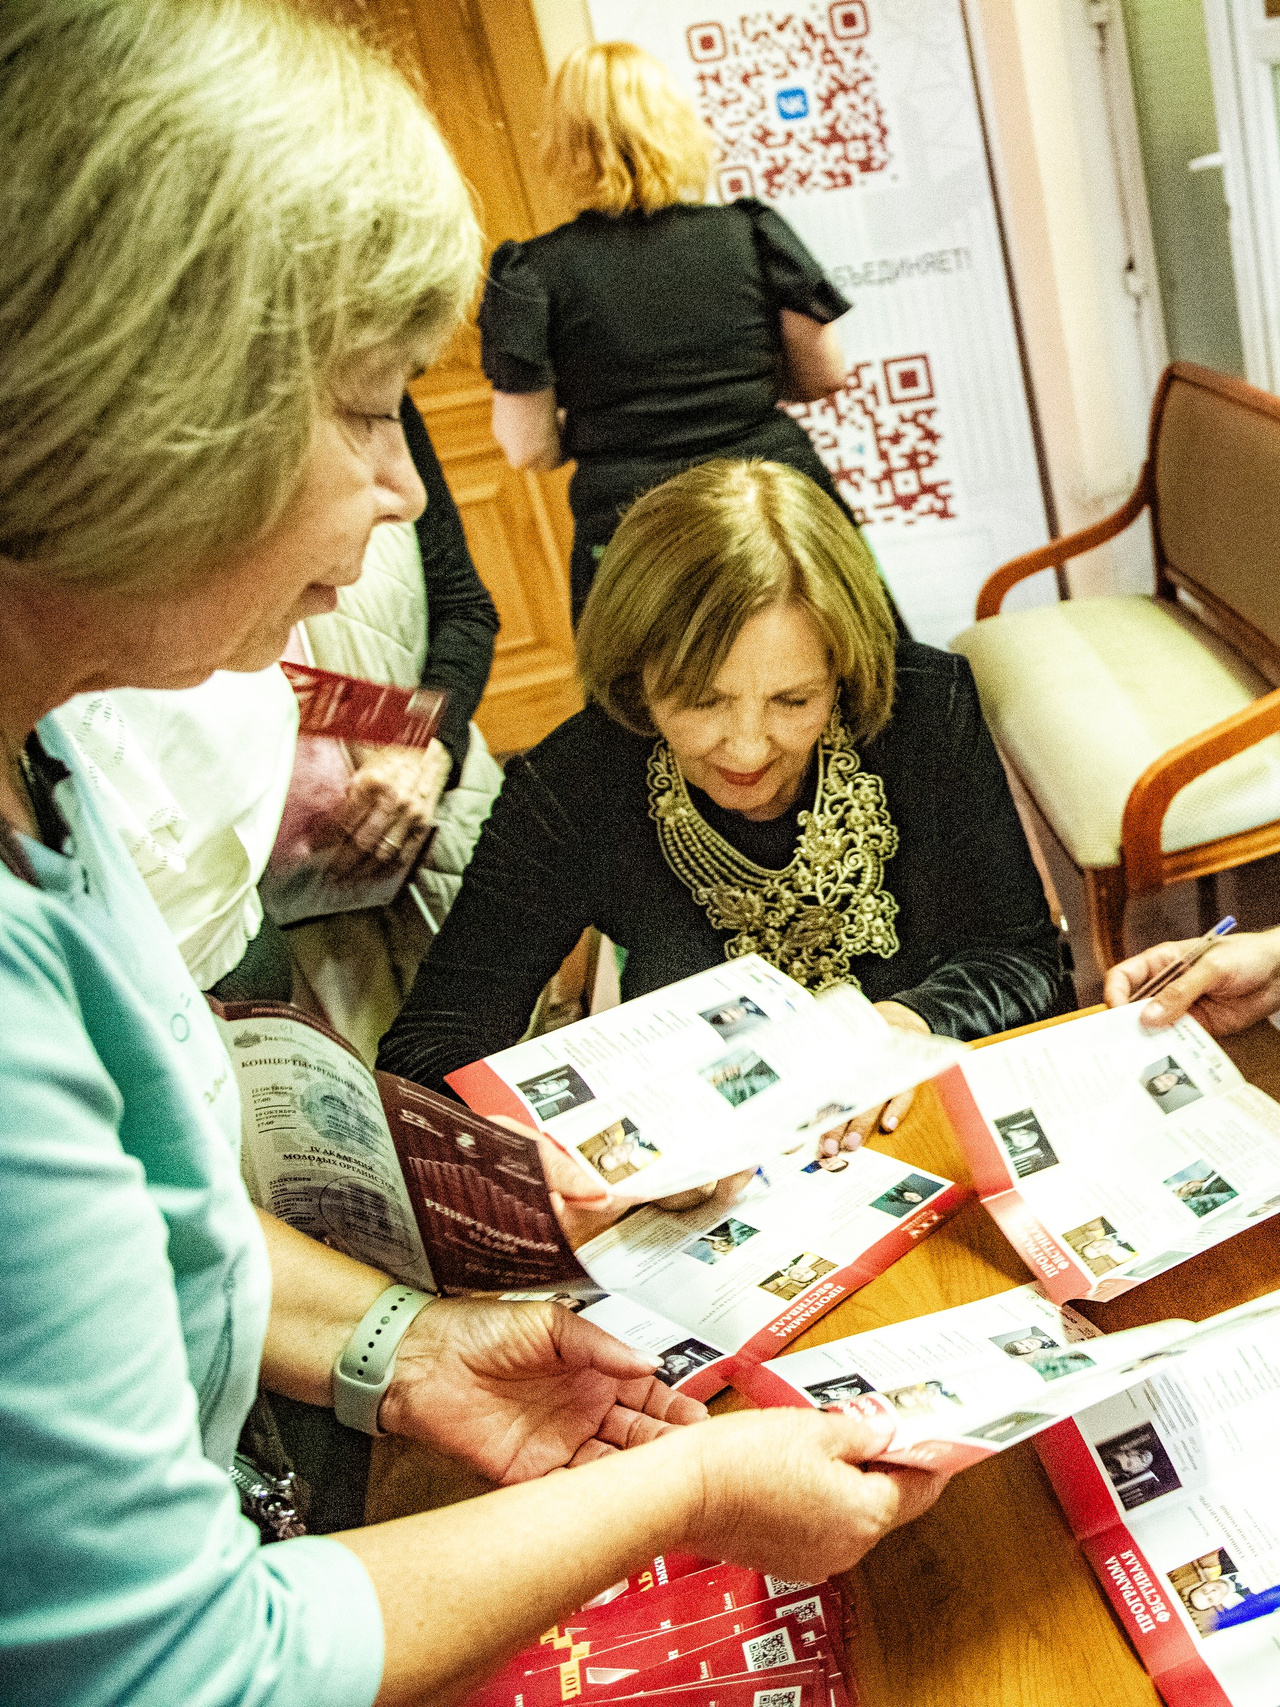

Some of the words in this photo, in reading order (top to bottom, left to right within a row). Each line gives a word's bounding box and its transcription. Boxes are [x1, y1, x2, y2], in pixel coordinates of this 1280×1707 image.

[832, 247, 972, 288] БЪЕДИНЯЕТ!
[241, 1057, 308, 1069] КОНЦЕРТЫ
[282, 1153, 337, 1166] МОЛОДЫХ
[323, 1148, 374, 1171] АКАДЕМИЯ
[767, 1281, 836, 1334] ФЕСТИВАЛЯ
[774, 1283, 846, 1338] ПРОГРАММА
[1104, 1555, 1157, 1635] ПРОГРАММА
[1118, 1550, 1172, 1625] ФЕСТИВАЛЯ
